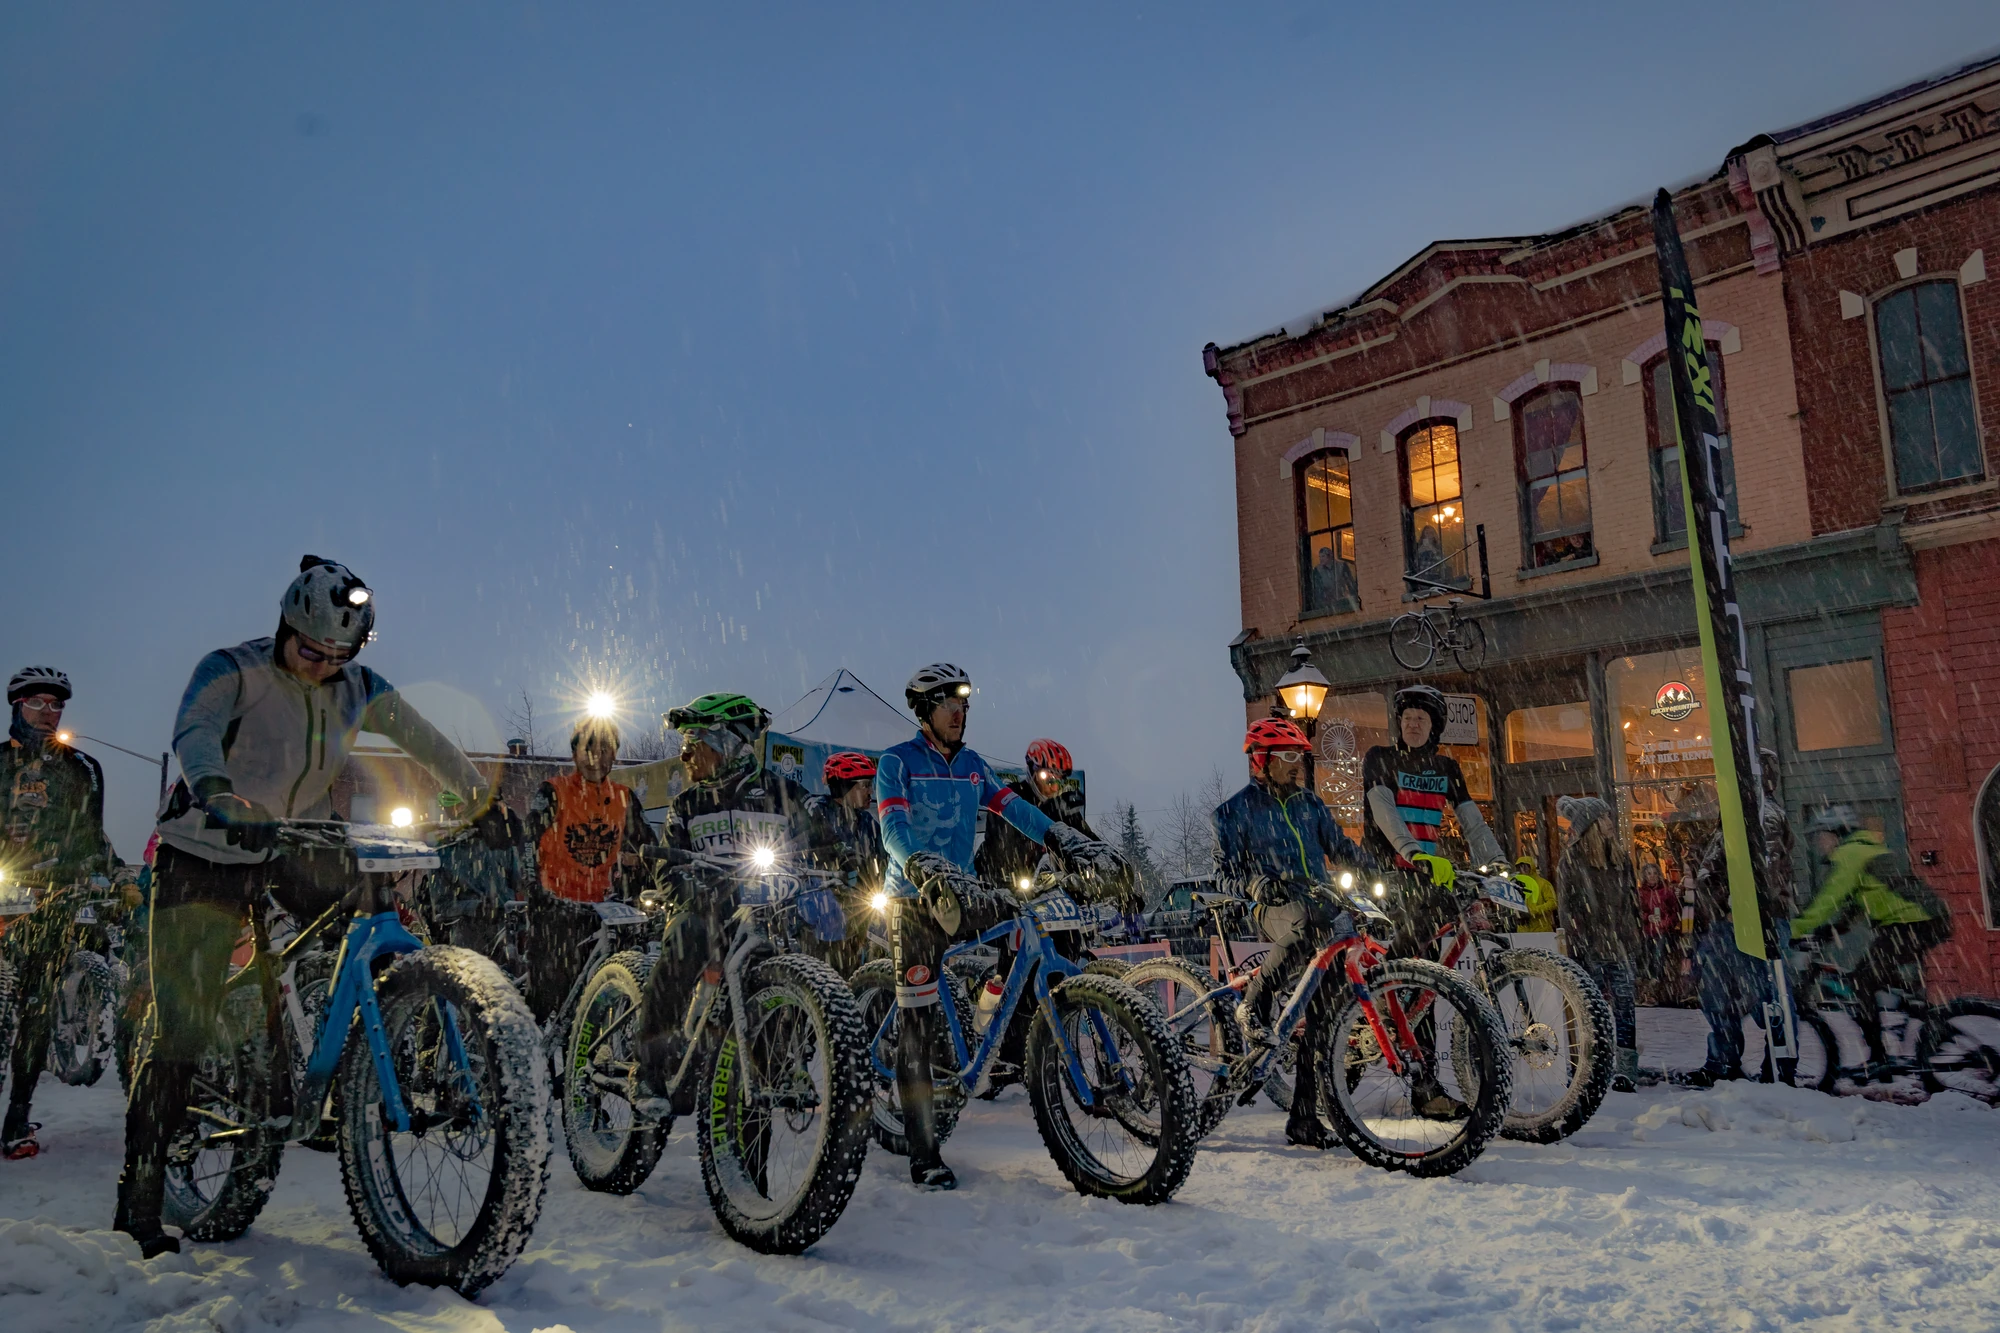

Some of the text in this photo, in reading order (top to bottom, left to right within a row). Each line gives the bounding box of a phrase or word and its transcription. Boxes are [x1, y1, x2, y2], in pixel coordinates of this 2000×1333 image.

[1447, 701, 1475, 726] SHOP
[1658, 741, 1675, 752] SKI
[1658, 752, 1680, 763] BIKE
[1402, 775, 1445, 791] CRANDIC
[690, 818, 786, 838] ERBALIFE
[1047, 898, 1076, 918] 115
[342, 1123, 379, 1236] BONTRAGER
